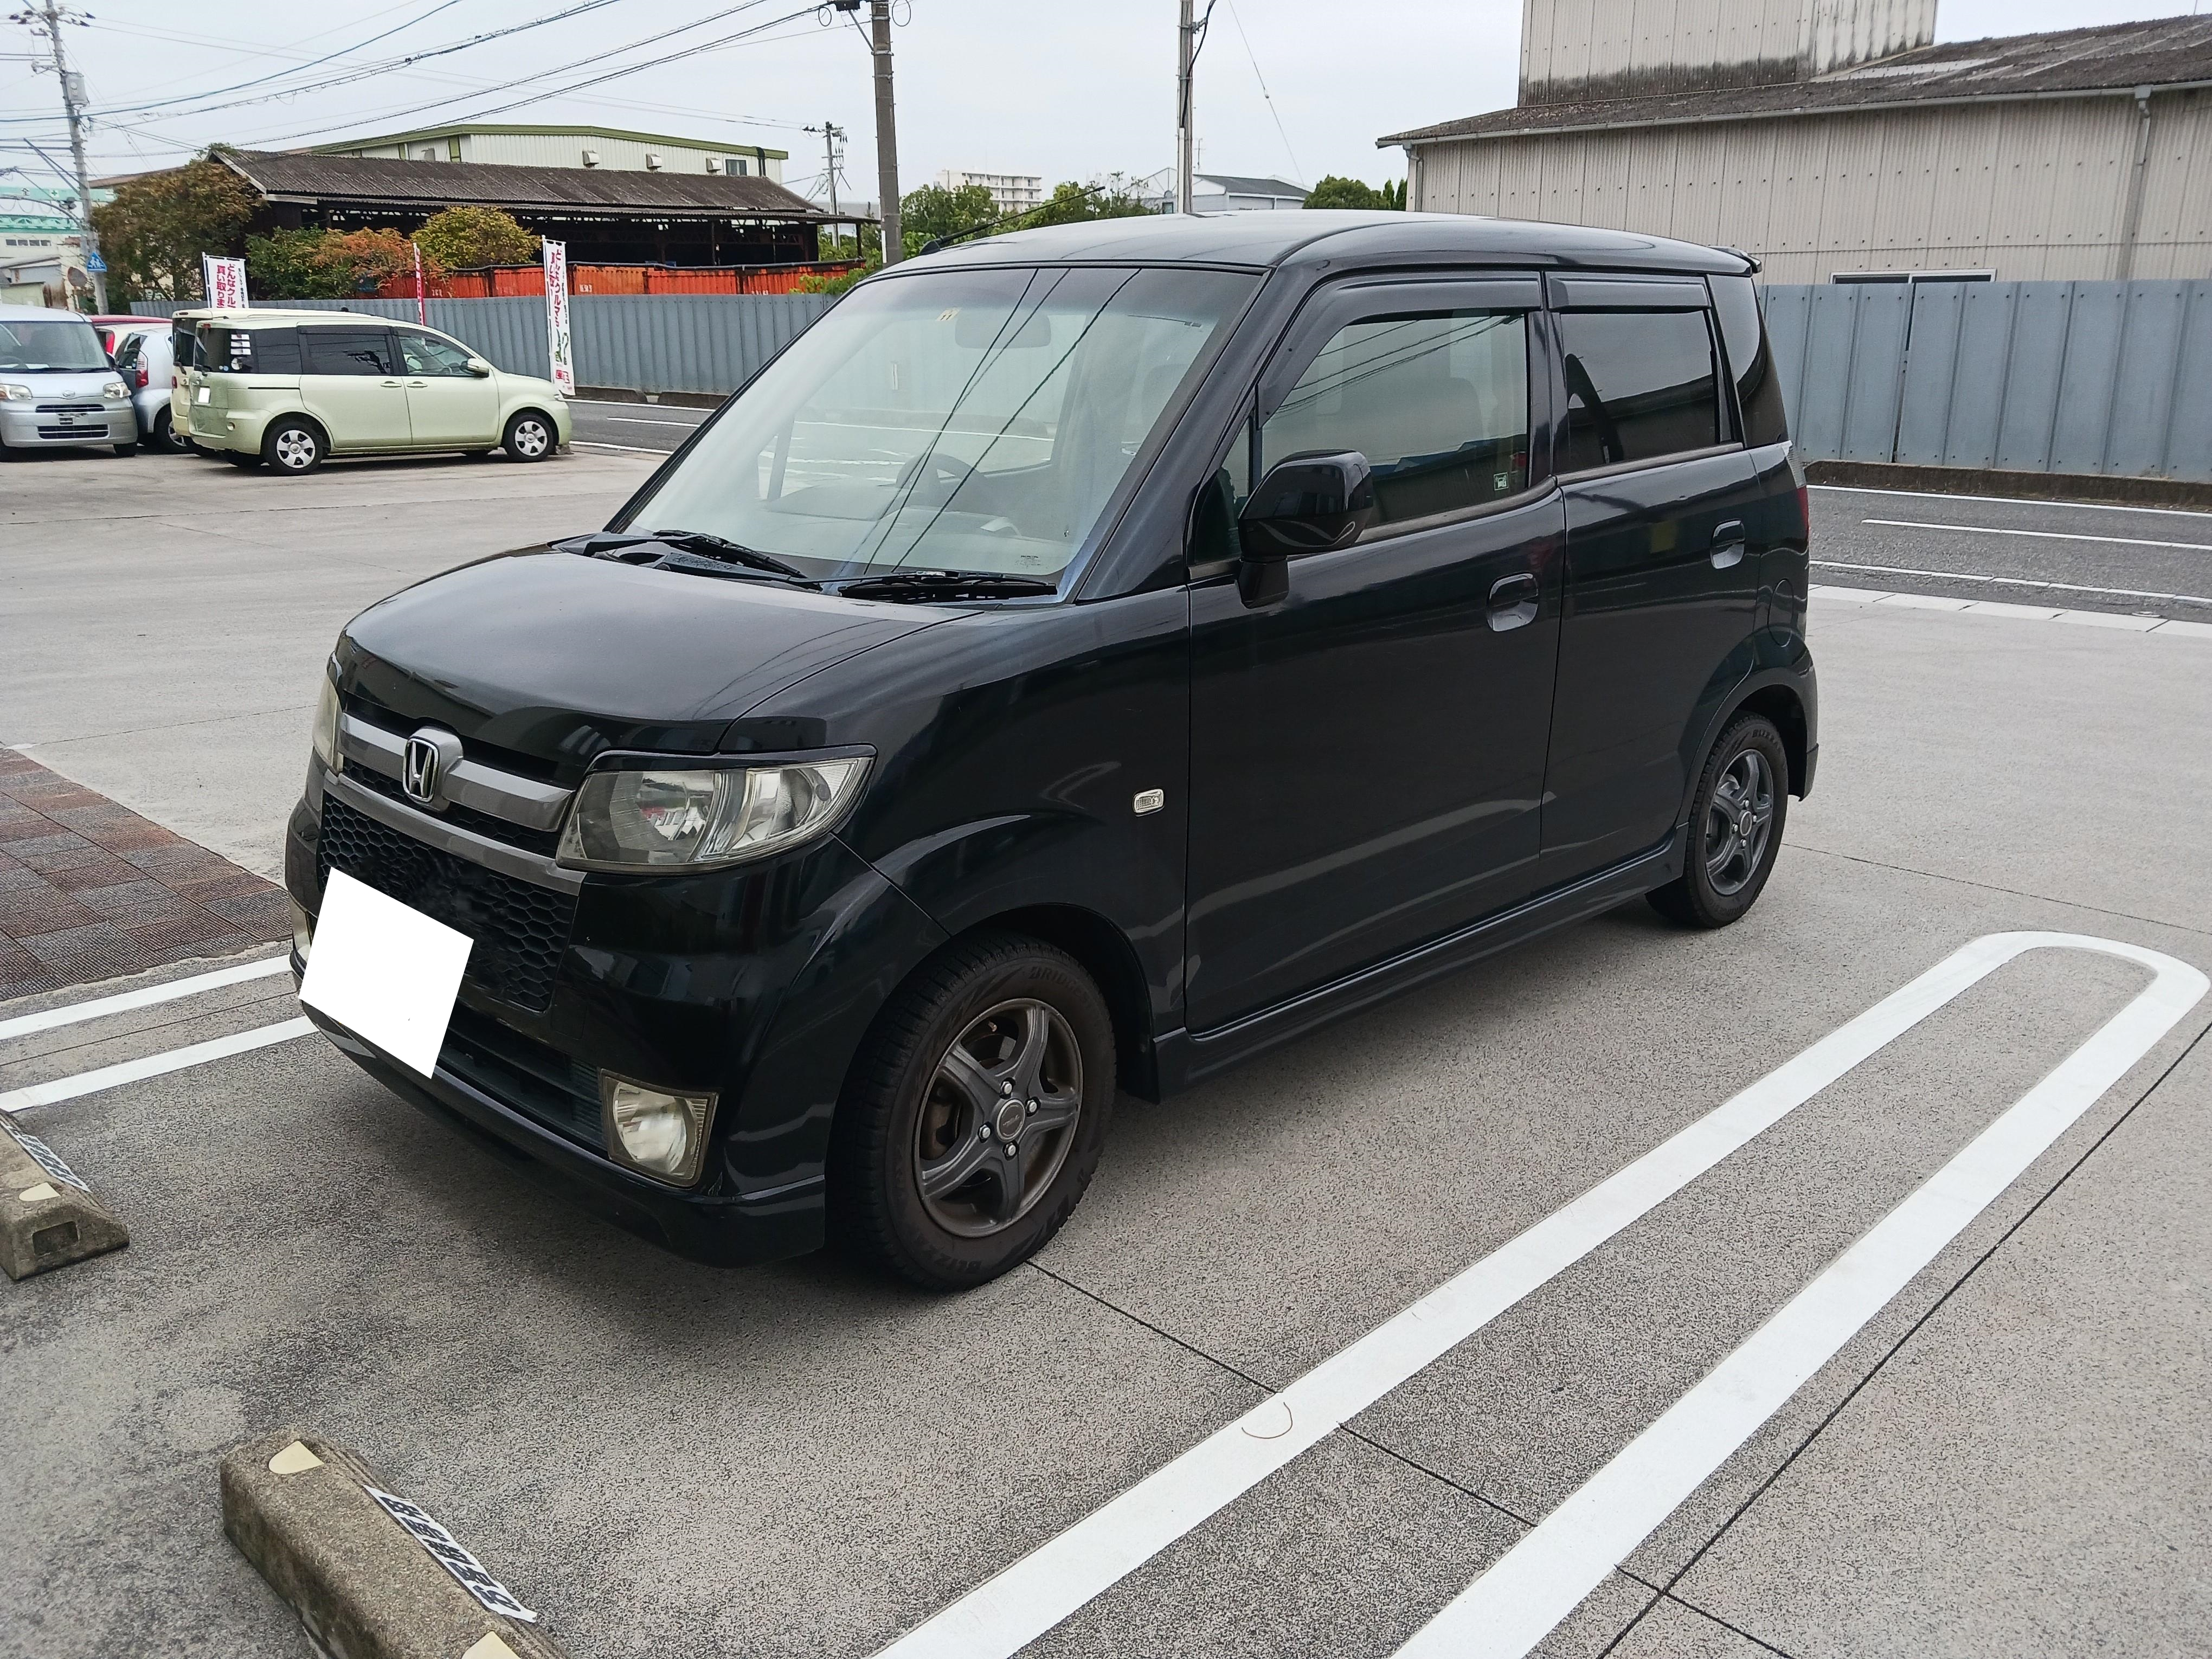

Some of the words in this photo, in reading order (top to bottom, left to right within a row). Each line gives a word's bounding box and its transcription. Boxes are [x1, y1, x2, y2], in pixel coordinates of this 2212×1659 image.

[217, 265, 226, 308] 買い取りま
[379, 1496, 521, 1612] お客様専用
